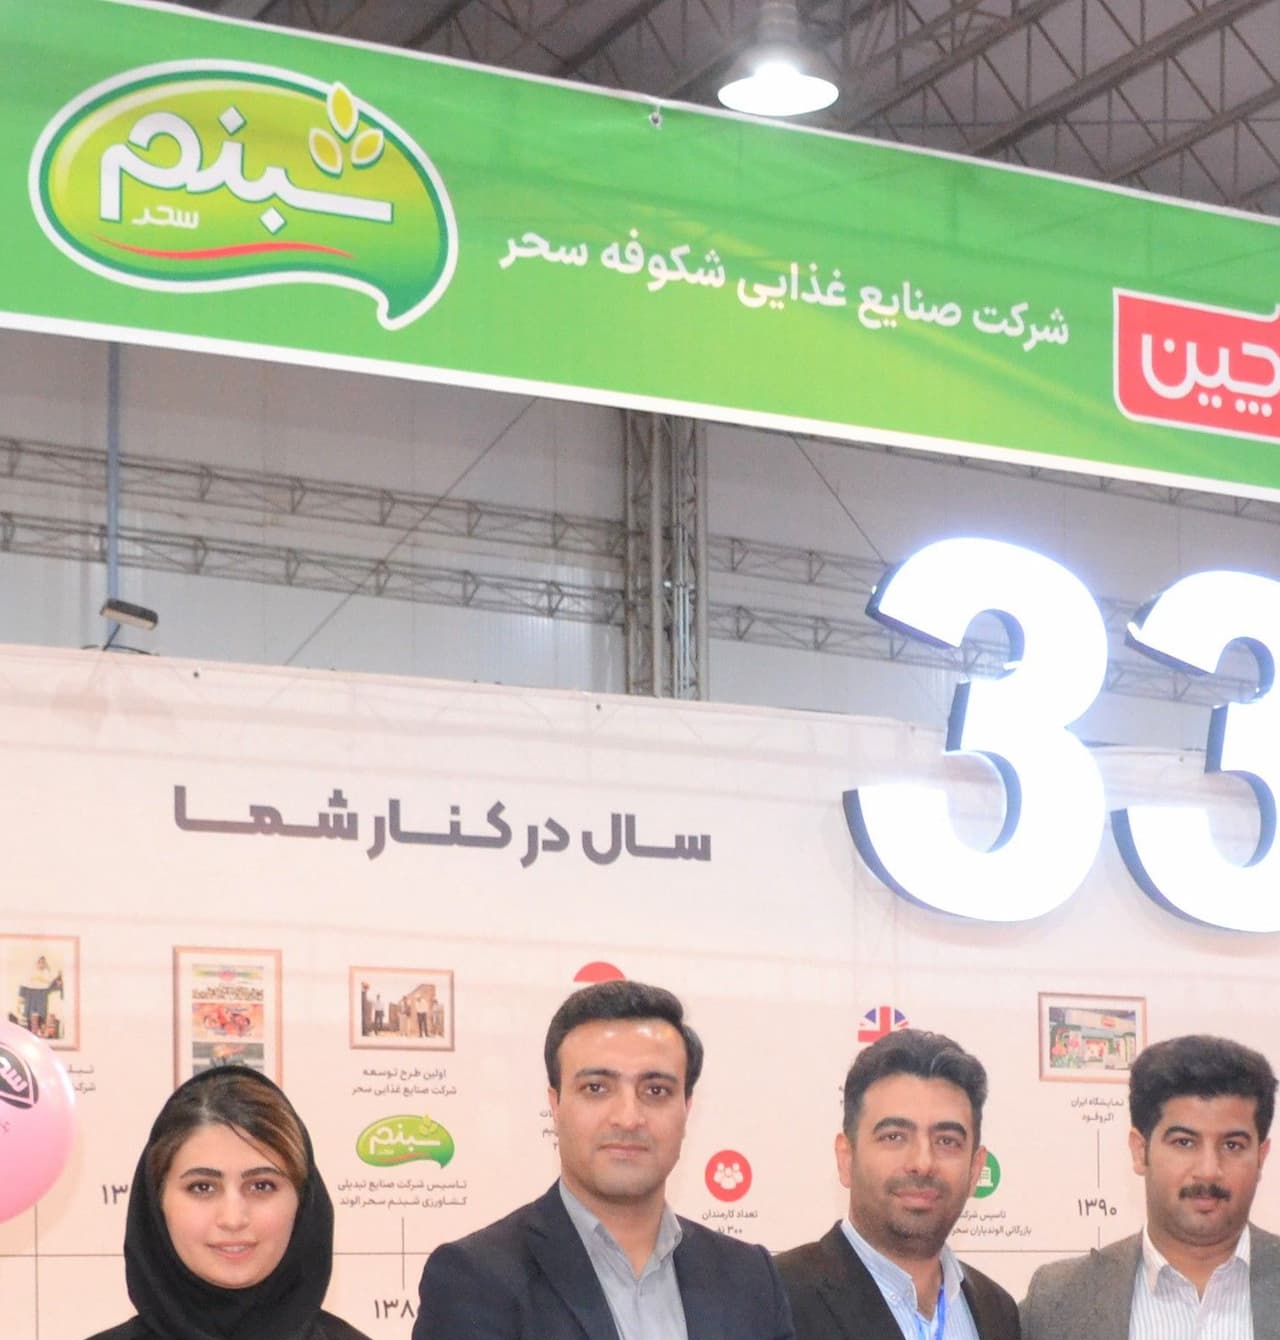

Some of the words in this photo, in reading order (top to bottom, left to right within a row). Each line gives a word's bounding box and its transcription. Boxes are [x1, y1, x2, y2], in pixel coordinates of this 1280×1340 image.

[100, 82, 394, 236] شبنم
[131, 204, 200, 230] سحر
[498, 231, 589, 269] سحر
[599, 227, 727, 292] شکوفه
[736, 261, 848, 312] غذایی
[856, 280, 963, 330] صنایع
[971, 301, 1071, 352] شرکت
[173, 784, 359, 841] شما
[366, 798, 513, 861] کنار
[581, 810, 713, 866] سال
[519, 816, 571, 869] در
[399, 1067, 422, 1081] طرح
[1077, 1197, 1118, 1218] ۱۳۹۰
[374, 1298, 416, 1320] ۱۳۸
